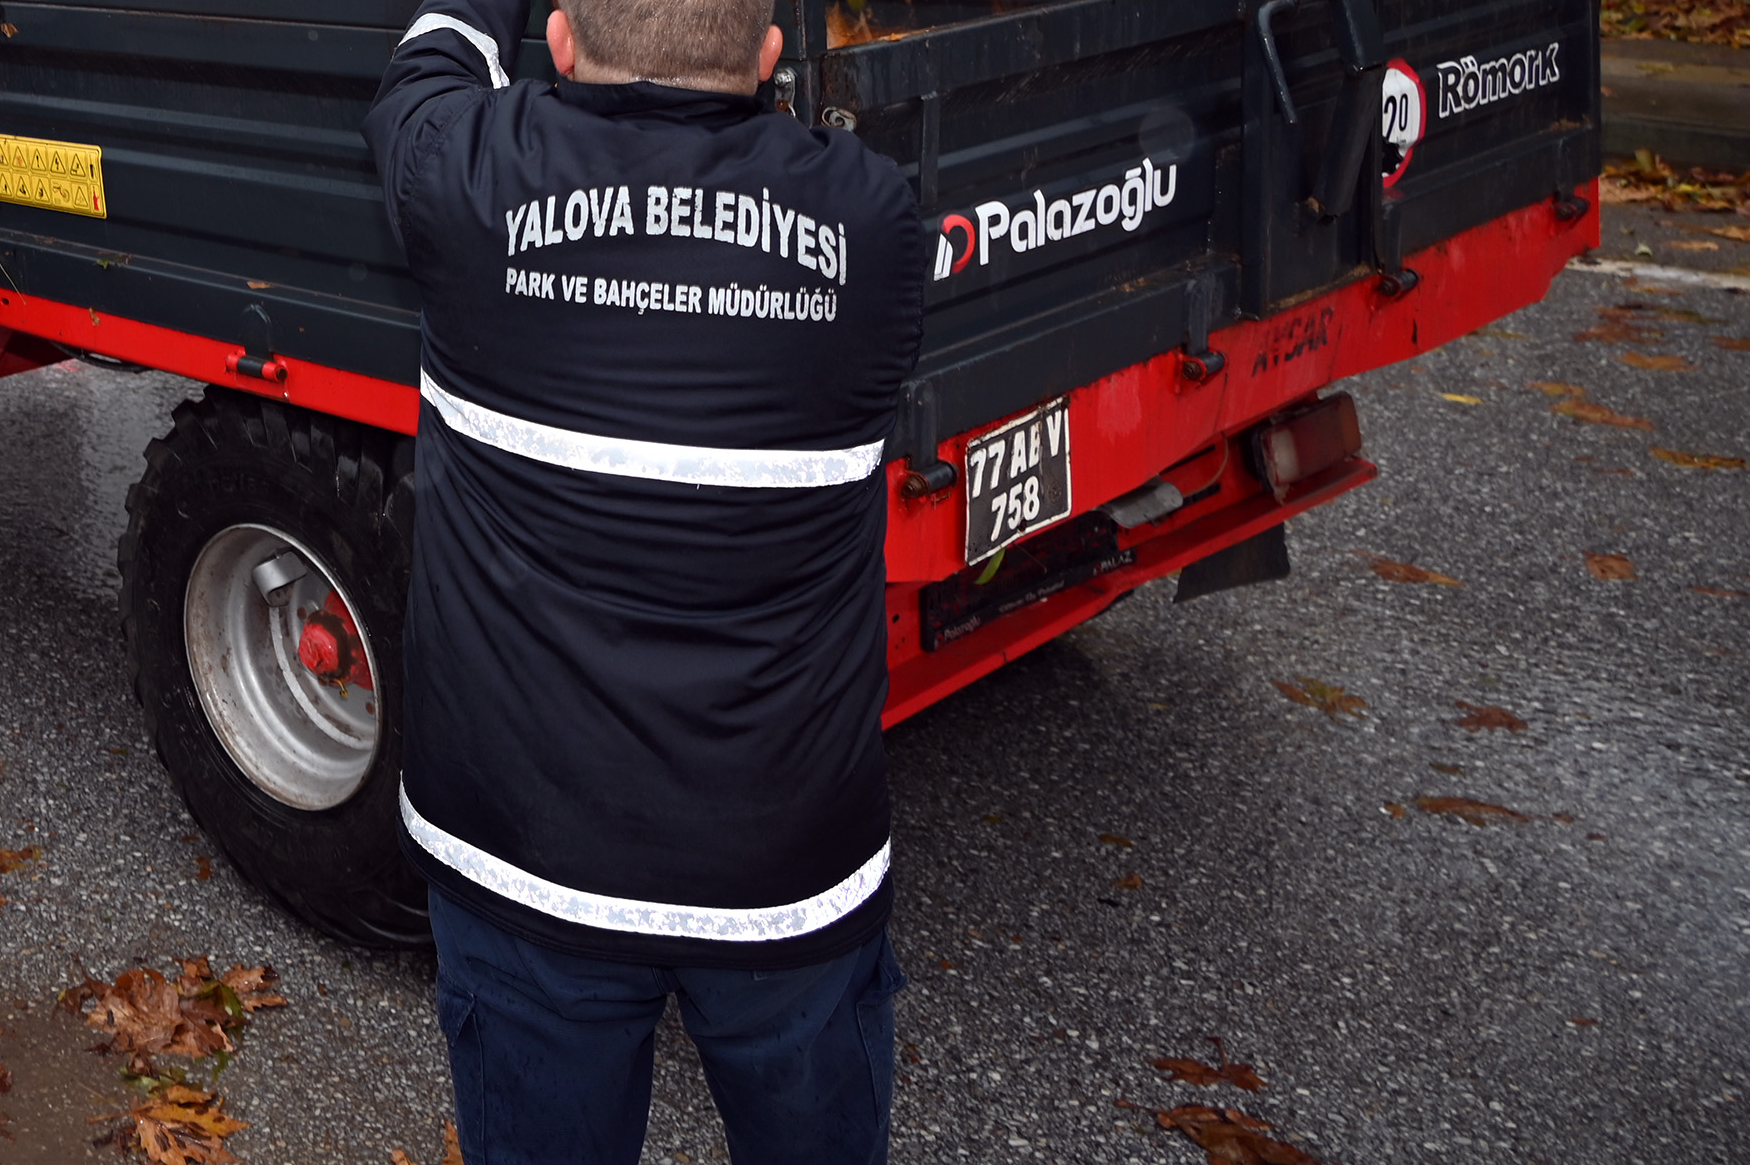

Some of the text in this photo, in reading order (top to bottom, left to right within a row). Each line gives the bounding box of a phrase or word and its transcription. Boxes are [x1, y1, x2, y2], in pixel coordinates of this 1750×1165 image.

[1436, 42, 1560, 118] Römork
[505, 186, 847, 285] YALOVA BELEDİYESİ
[975, 157, 1177, 265] Palazoğlu
[505, 267, 838, 322] PARK VE BAHÇELER MÜDÜRLÜĞÜ
[970, 439, 1006, 498] 77
[990, 475, 1041, 542] 758
